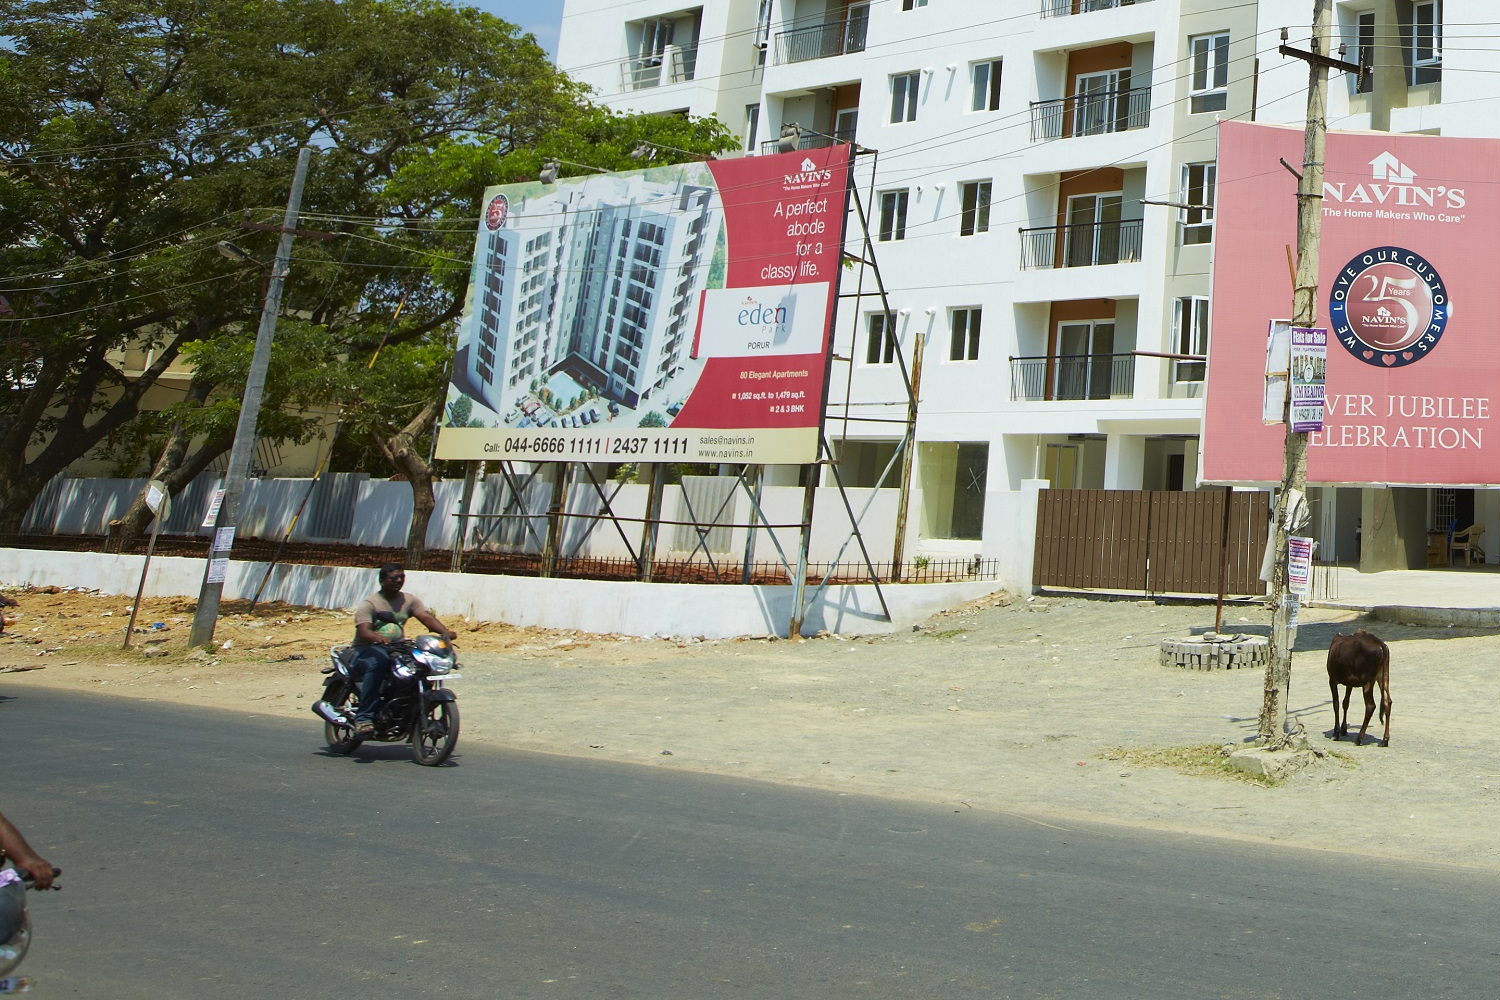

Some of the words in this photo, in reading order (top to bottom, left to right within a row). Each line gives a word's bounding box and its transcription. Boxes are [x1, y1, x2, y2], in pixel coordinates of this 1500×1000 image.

[783, 170, 831, 184] NAVIN'S
[1321, 182, 1466, 209] NAVIN'S
[773, 202, 783, 217] A
[786, 197, 828, 220] perfect
[1344, 209, 1373, 218] Home
[1375, 210, 1411, 220] Makers
[1413, 212, 1436, 222] Who
[787, 219, 825, 236] abode
[796, 241, 812, 256] for
[814, 242, 823, 255] a
[1362, 250, 1398, 265] OUR
[761, 264, 798, 281] classy
[800, 261, 820, 277] life.
[1333, 267, 1356, 311] LOVE
[1388, 287, 1411, 296] Years
[1362, 274, 1419, 346] 25
[1405, 255, 1444, 351] CUSTOMERS
[1362, 315, 1406, 324] NAVIN'S
[761, 325, 786, 334] Park
[1338, 325, 1356, 349] WE
[747, 341, 770, 349] PORUR
[749, 370, 772, 380] Elegant
[772, 369, 809, 379] Apartments
[775, 405, 780, 413] 2
[791, 404, 805, 413] BHK
[1386, 395, 1490, 419] JUBILEE
[484, 442, 500, 453] Call:
[504, 436, 566, 453] 044-6666
[570, 437, 601, 454] 1111
[613, 437, 648, 454] 2437
[653, 437, 688, 454] 1111
[699, 435, 754, 445] sales@navins.in
[698, 449, 753, 458] www.navins.in
